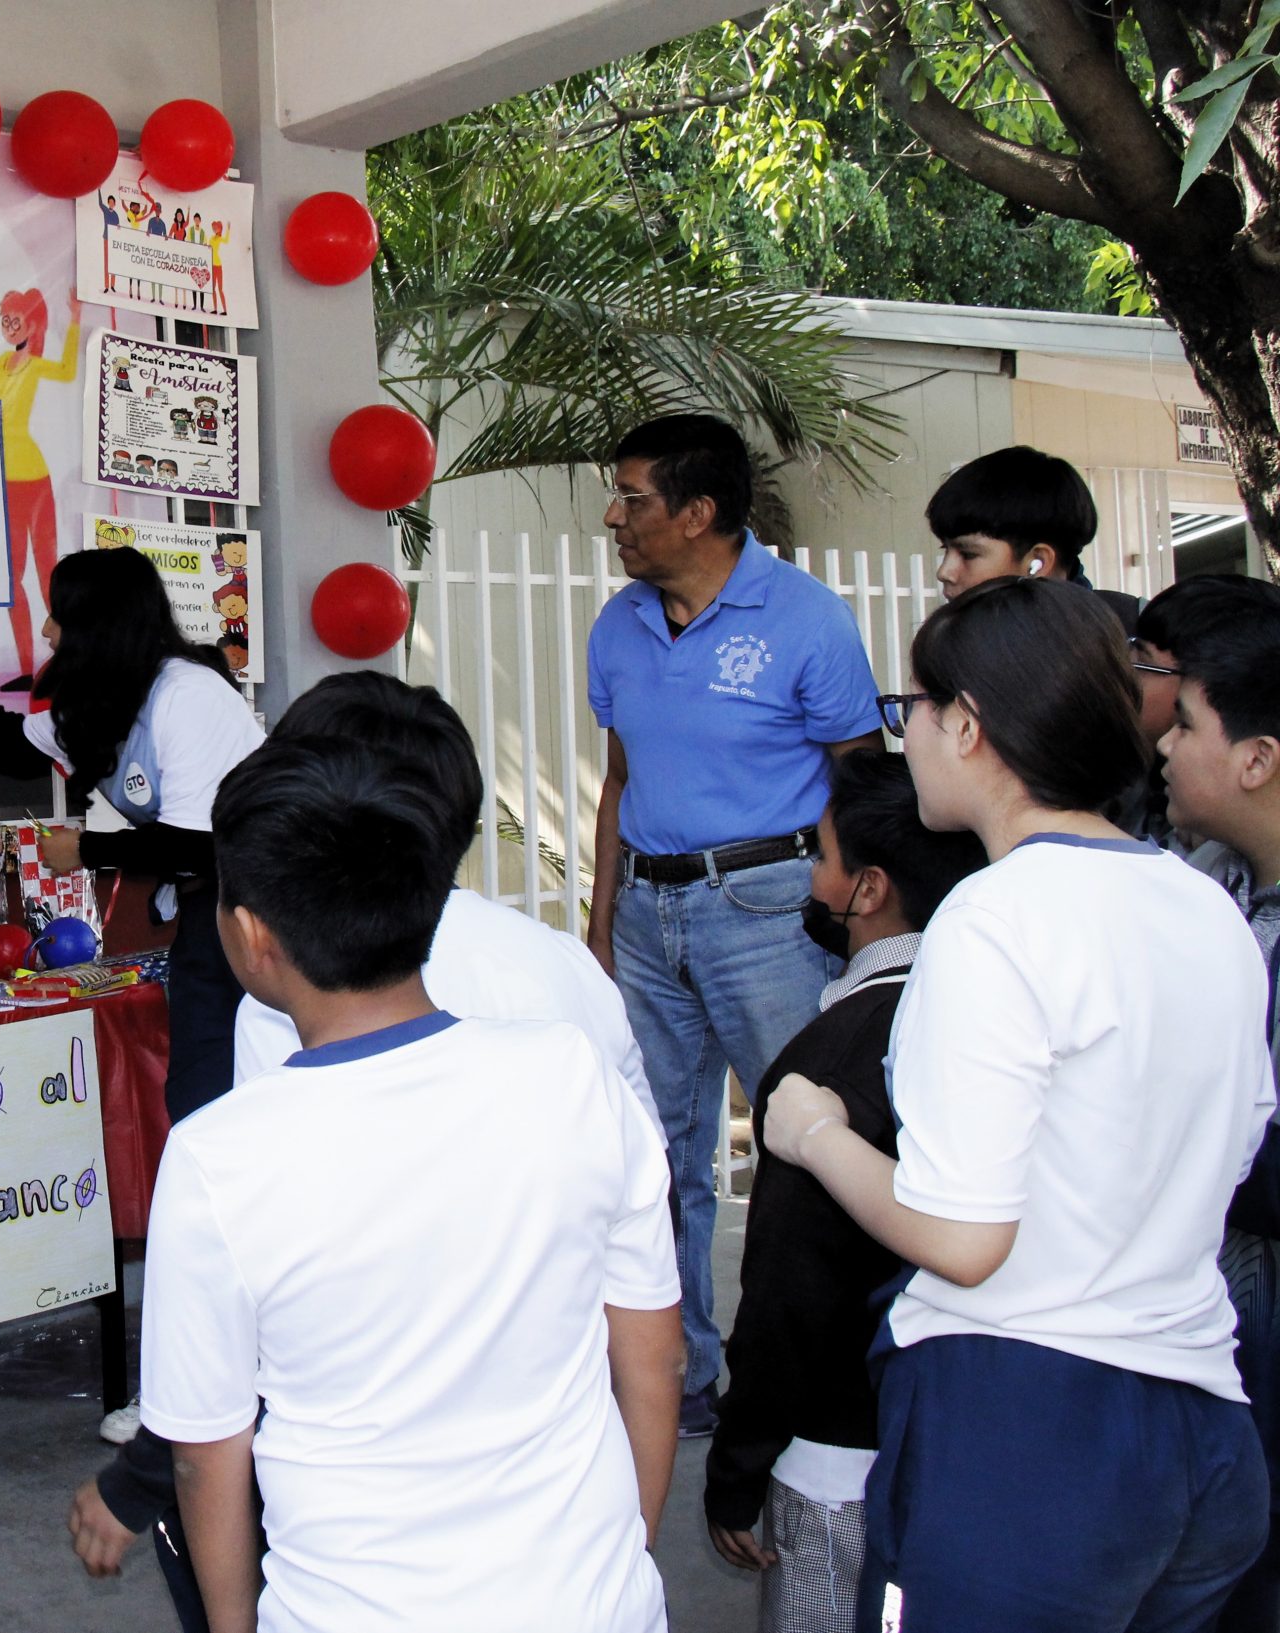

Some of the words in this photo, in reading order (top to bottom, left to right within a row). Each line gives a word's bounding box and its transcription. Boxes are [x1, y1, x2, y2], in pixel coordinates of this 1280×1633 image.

[112, 241, 123, 250] EN
[124, 243, 140, 253] ESTA
[142, 246, 170, 260] ESCUELA
[172, 254, 179, 262] SE
[181, 255, 207, 267] ENSEÑA
[131, 255, 146, 265] CON
[147, 259, 155, 267] EL
[156, 260, 190, 274] CORAZÓN
[130, 353, 165, 366] Receta
[169, 362, 194, 371] para
[199, 365, 208, 373] la
[1200, 428, 1209, 444] DE
[156, 534, 211, 547] verdaderos
[192, 582, 204, 590] en
[201, 622, 209, 632] el
[125, 774, 145, 791] GTO
[41, 1037, 86, 1105] al
